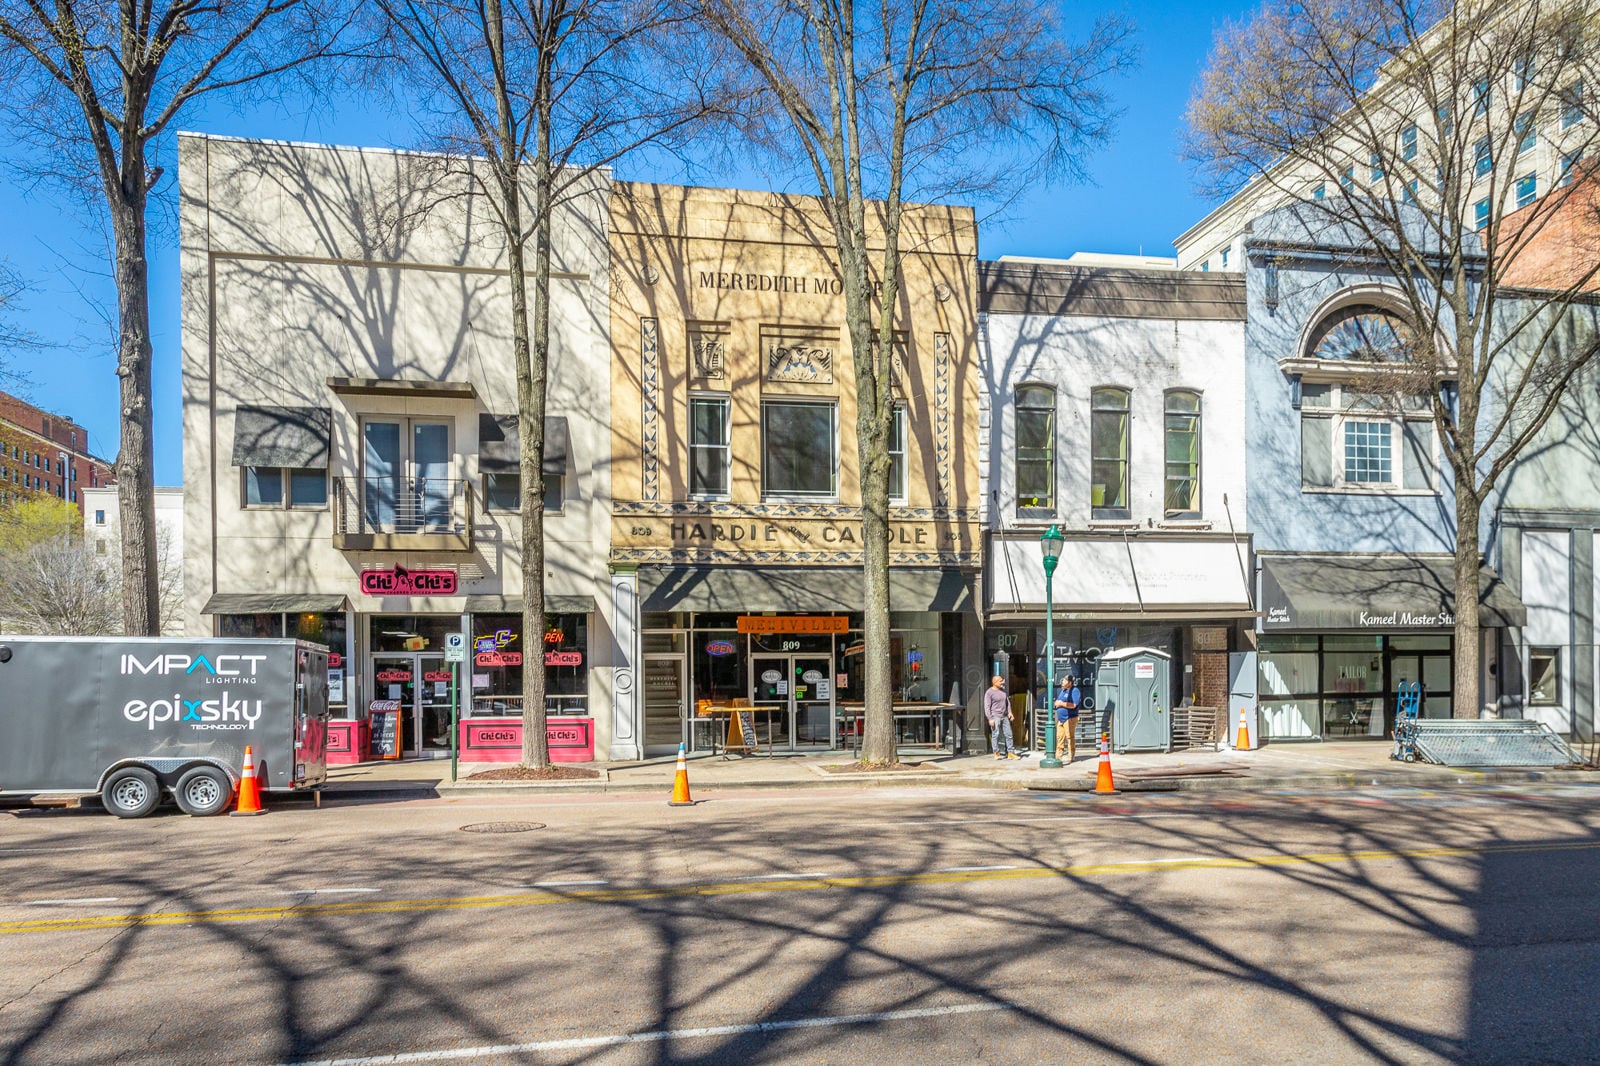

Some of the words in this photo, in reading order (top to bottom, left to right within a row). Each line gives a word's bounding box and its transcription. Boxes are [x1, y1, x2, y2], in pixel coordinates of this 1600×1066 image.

[700, 271, 807, 294] MEREDITH
[670, 523, 778, 541] HARDIE
[1360, 611, 1396, 626] Kameel
[1400, 612, 1436, 625] Master
[544, 633, 564, 643] PEN
[998, 634, 1018, 647] 807
[706, 644, 733, 654] OPEN
[783, 641, 800, 651] 809
[120, 653, 267, 675] IMPACT
[123, 691, 262, 730] epixsky
